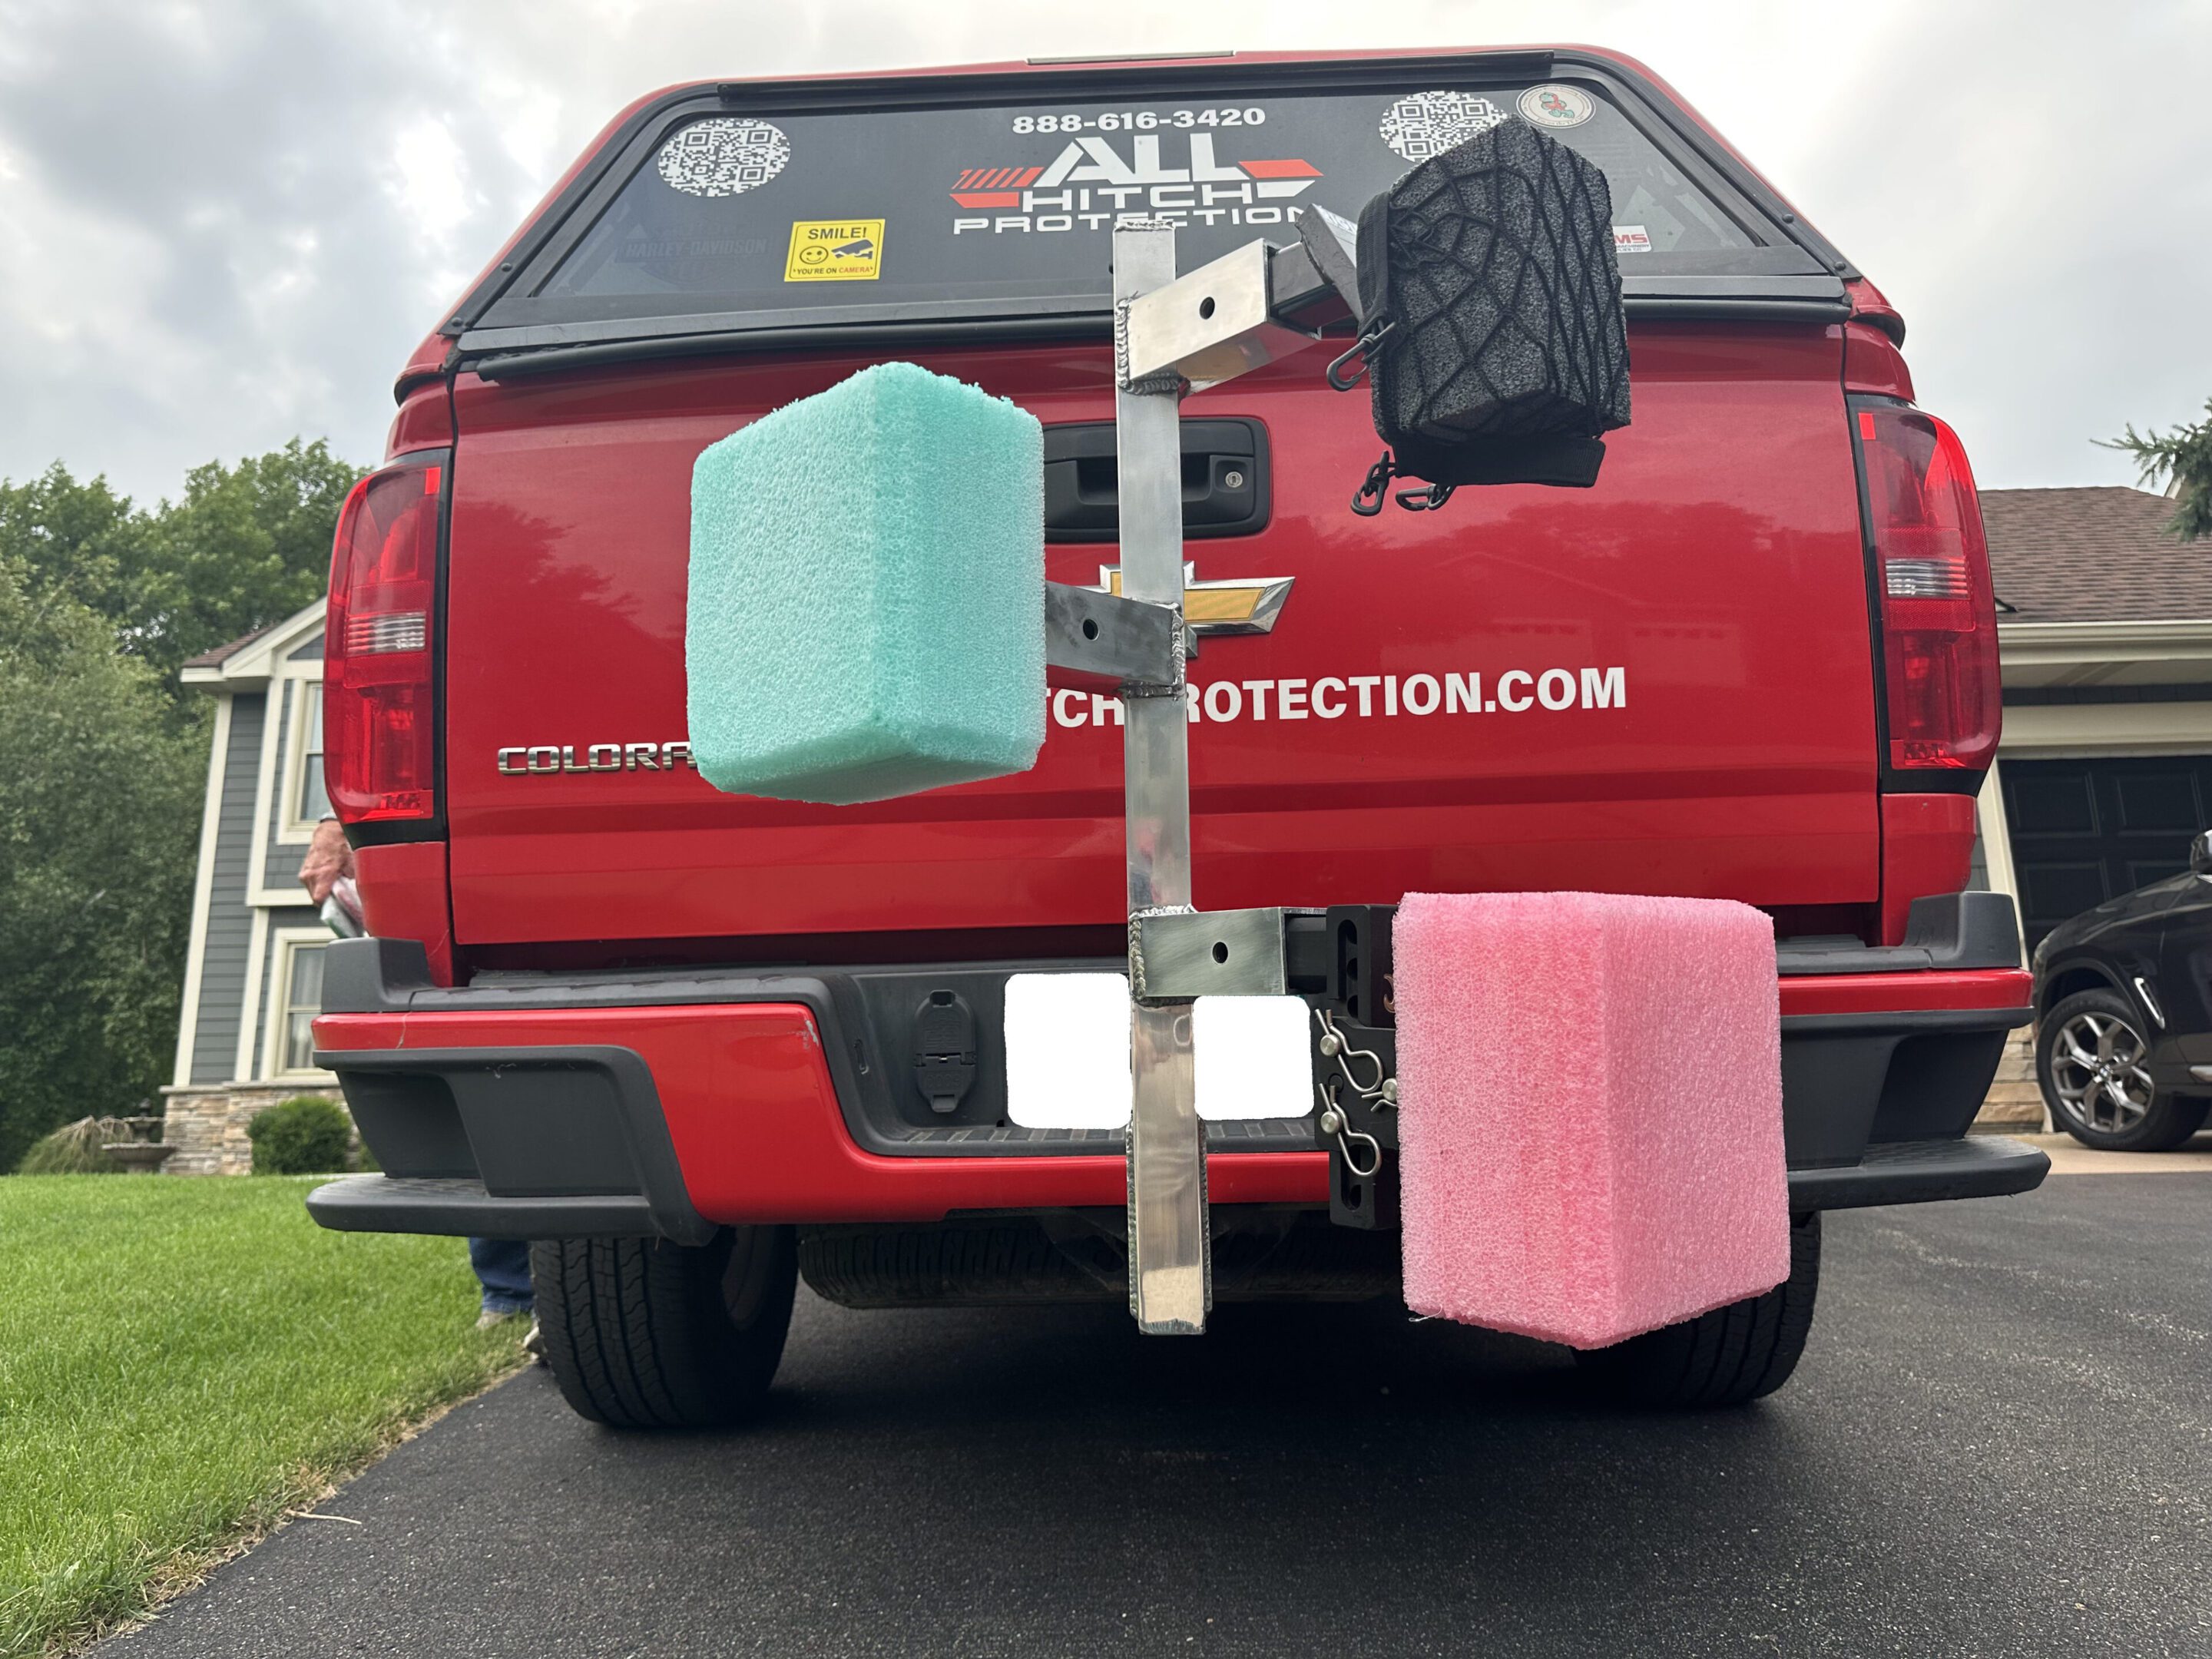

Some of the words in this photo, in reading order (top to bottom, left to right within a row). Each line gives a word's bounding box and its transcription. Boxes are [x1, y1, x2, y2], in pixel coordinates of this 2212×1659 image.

[1012, 108, 1266, 134] 888-616-3420
[1033, 132, 1250, 187] ALL
[1022, 183, 1252, 213] HITCH
[808, 227, 867, 240] SMILE!
[839, 266, 870, 274] CAMERA
[498, 741, 697, 774] COLORA
